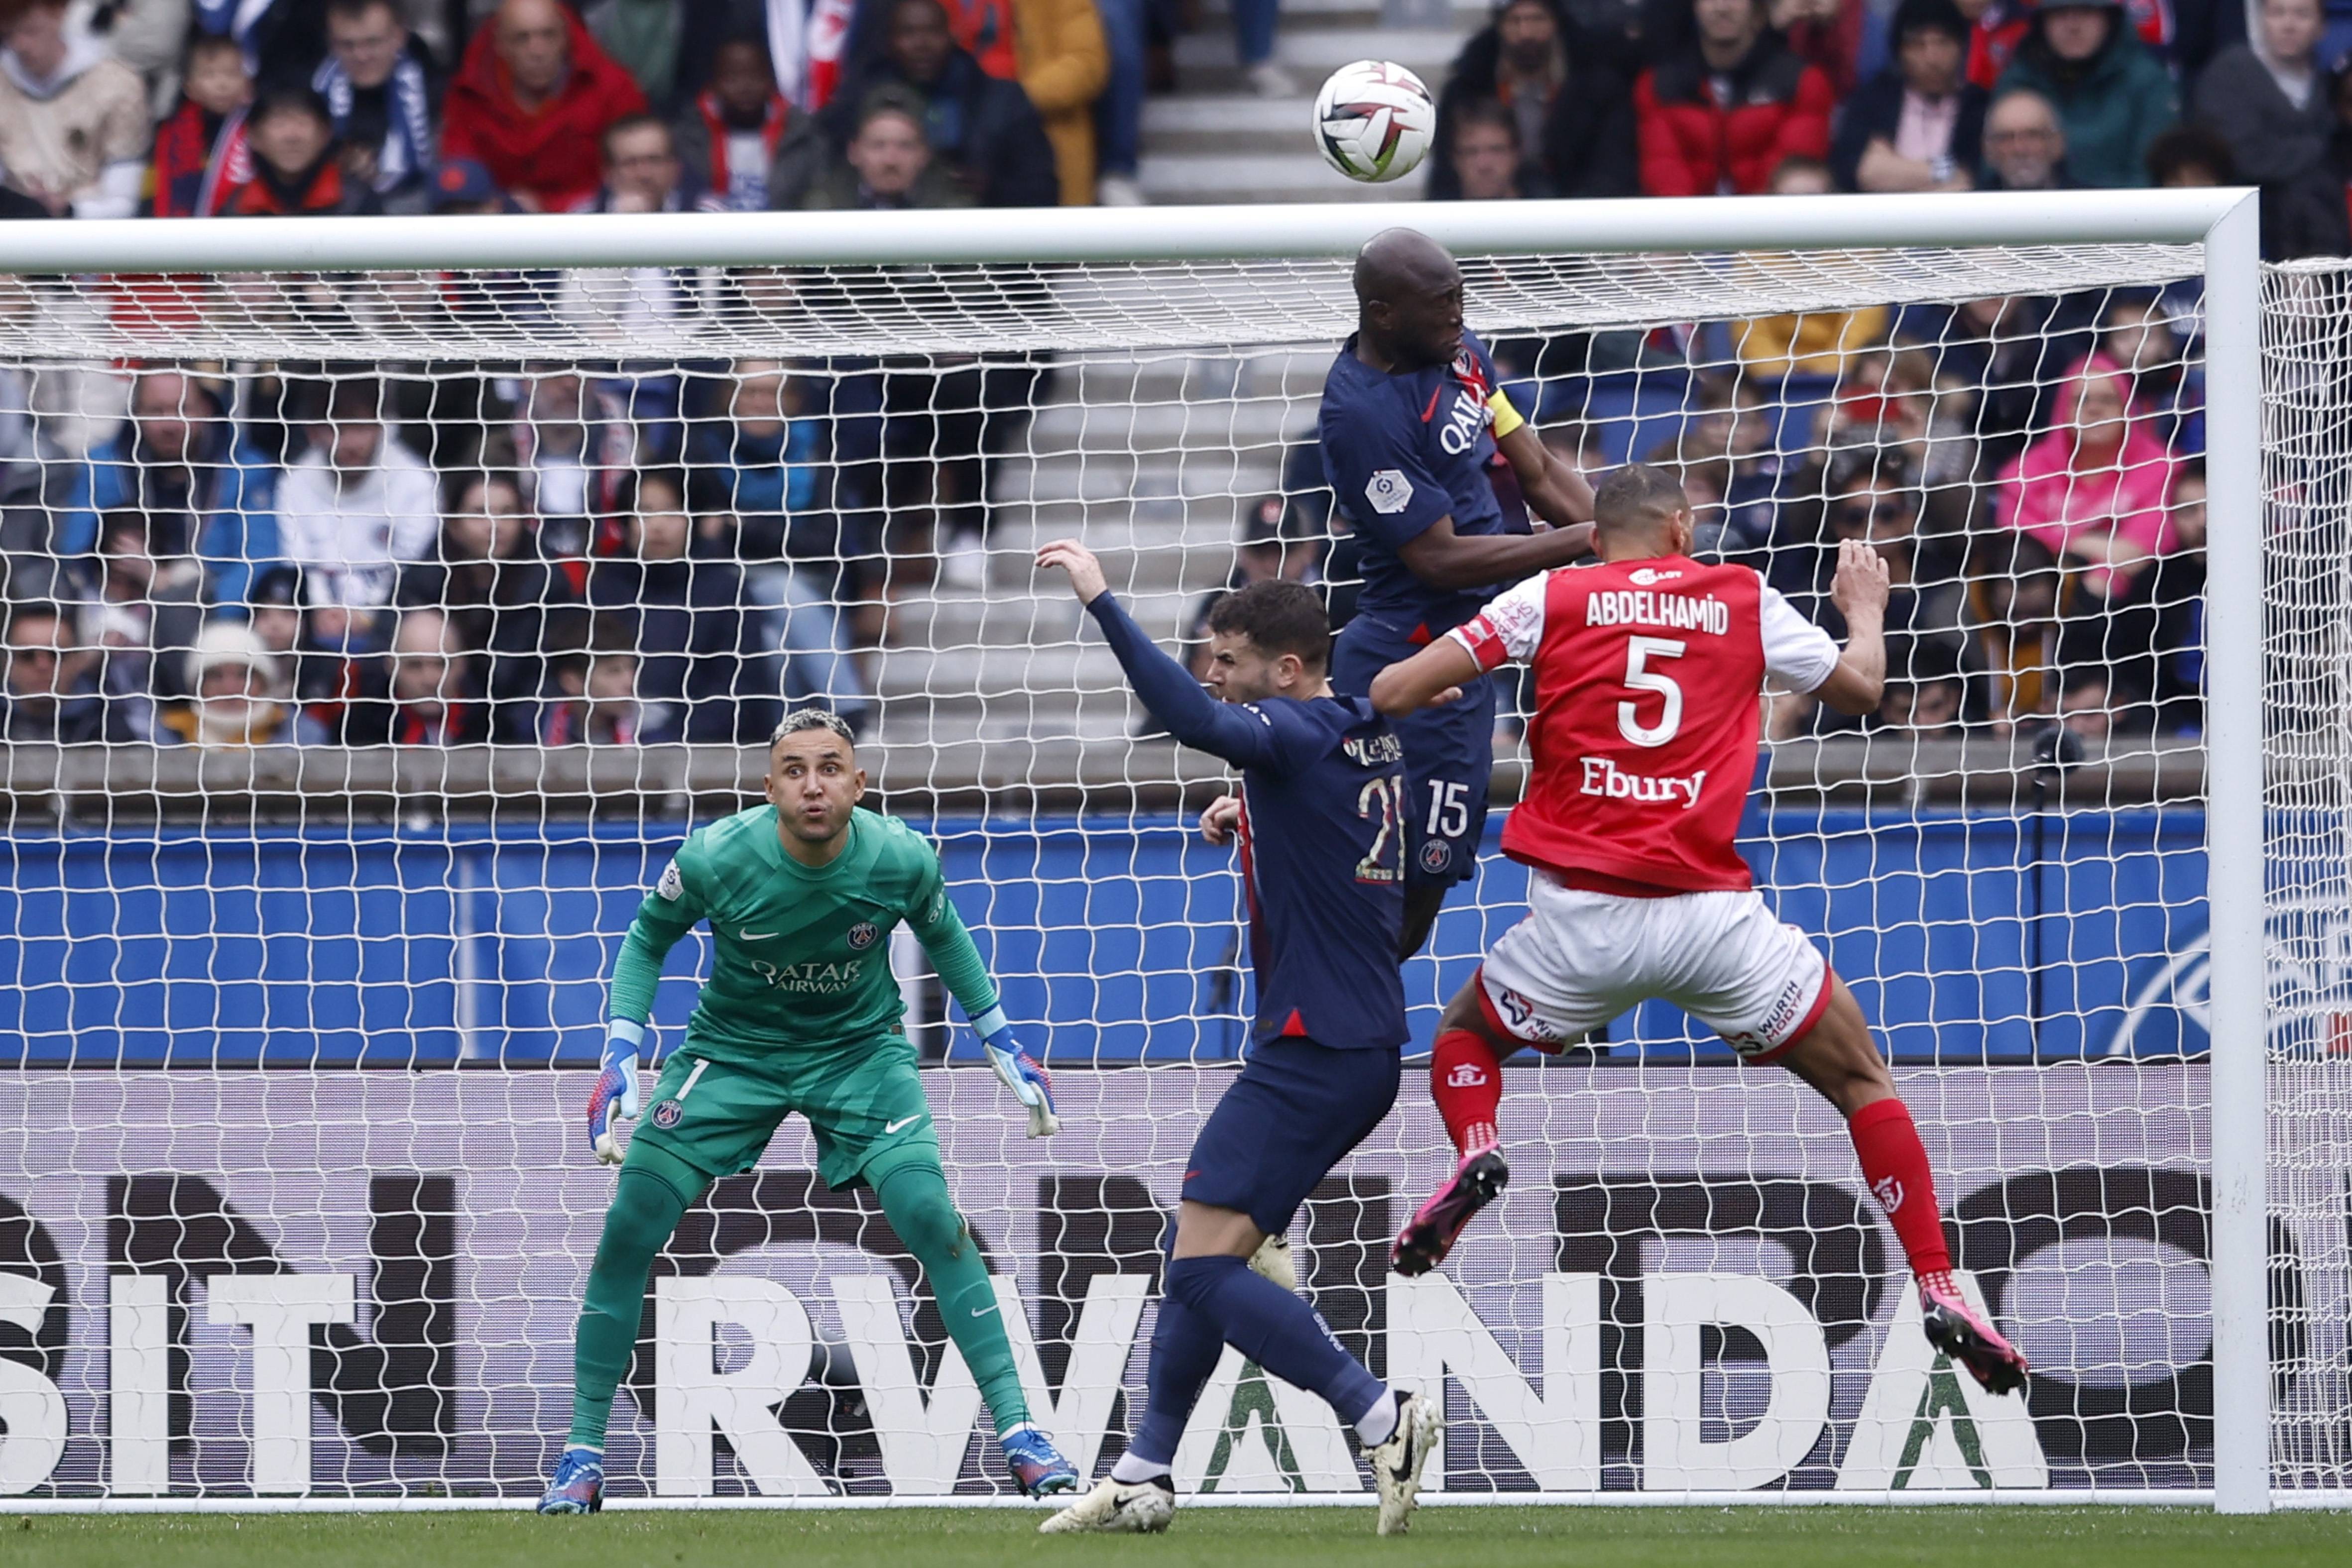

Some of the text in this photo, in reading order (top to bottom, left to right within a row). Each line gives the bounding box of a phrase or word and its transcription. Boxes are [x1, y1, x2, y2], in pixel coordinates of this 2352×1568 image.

[1618, 636, 1685, 747] 5
[1425, 779, 1469, 838] 15
[1579, 756, 1707, 809] Ebury
[1355, 775, 1405, 884] 21
[751, 959, 862, 985] QATAR
[675, 1058, 710, 1101] 1
[655, 1271, 2049, 1496] RWANDA
